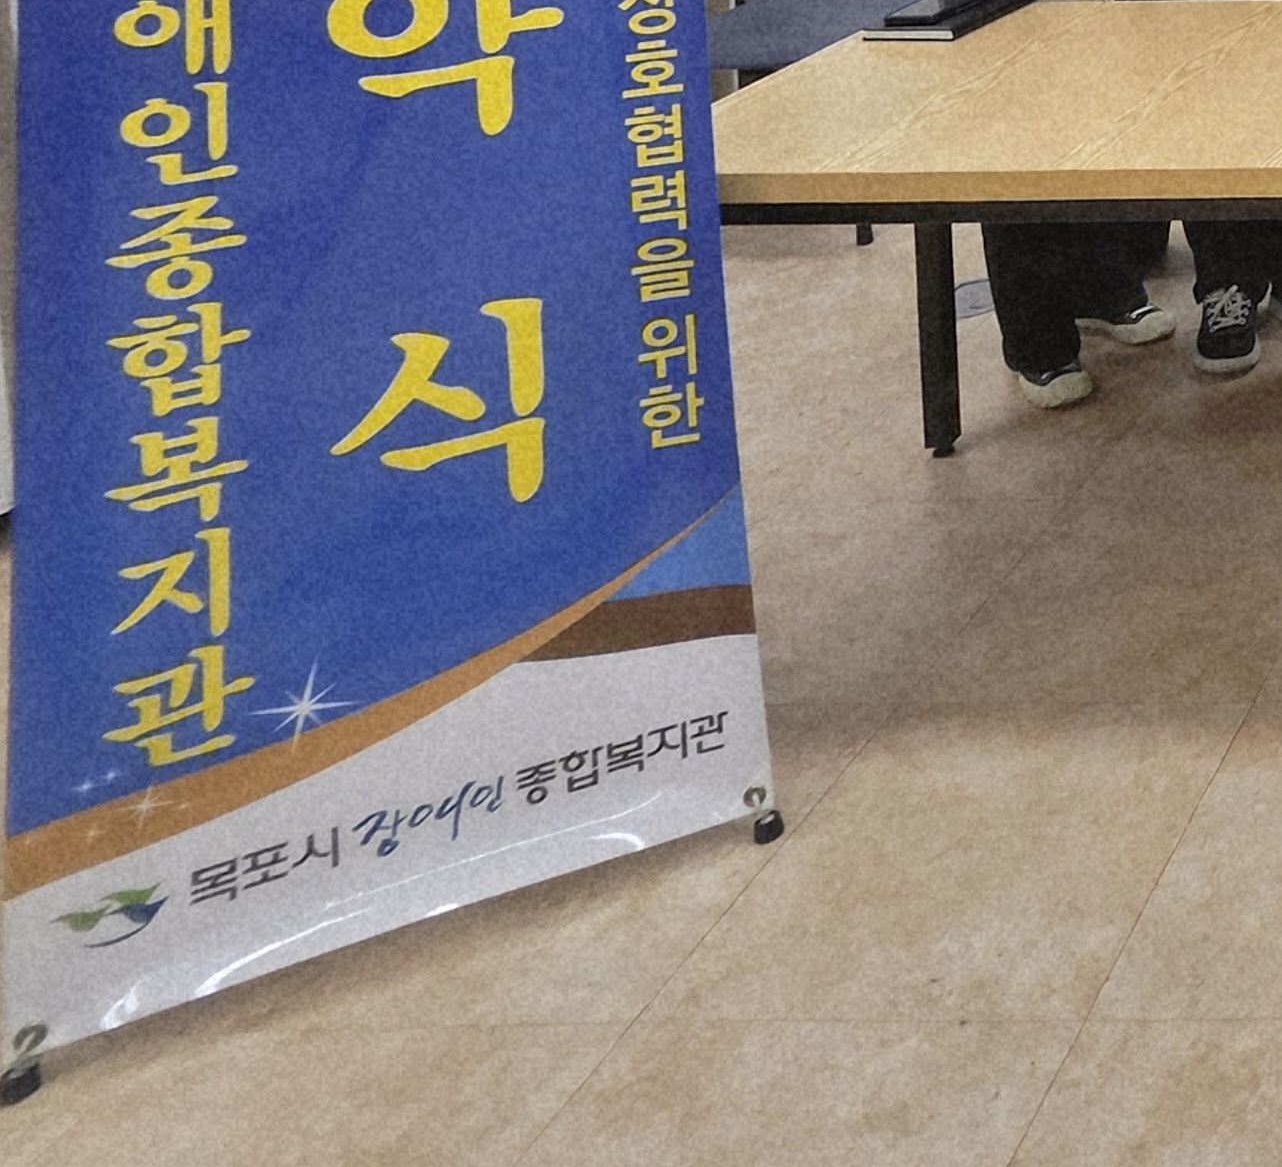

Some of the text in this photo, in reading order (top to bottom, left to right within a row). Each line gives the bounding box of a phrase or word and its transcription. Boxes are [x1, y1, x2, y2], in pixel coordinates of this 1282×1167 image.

[638, 314, 704, 449] 위한
[189, 710, 728, 906] 목포시 장애인 종합복지관
